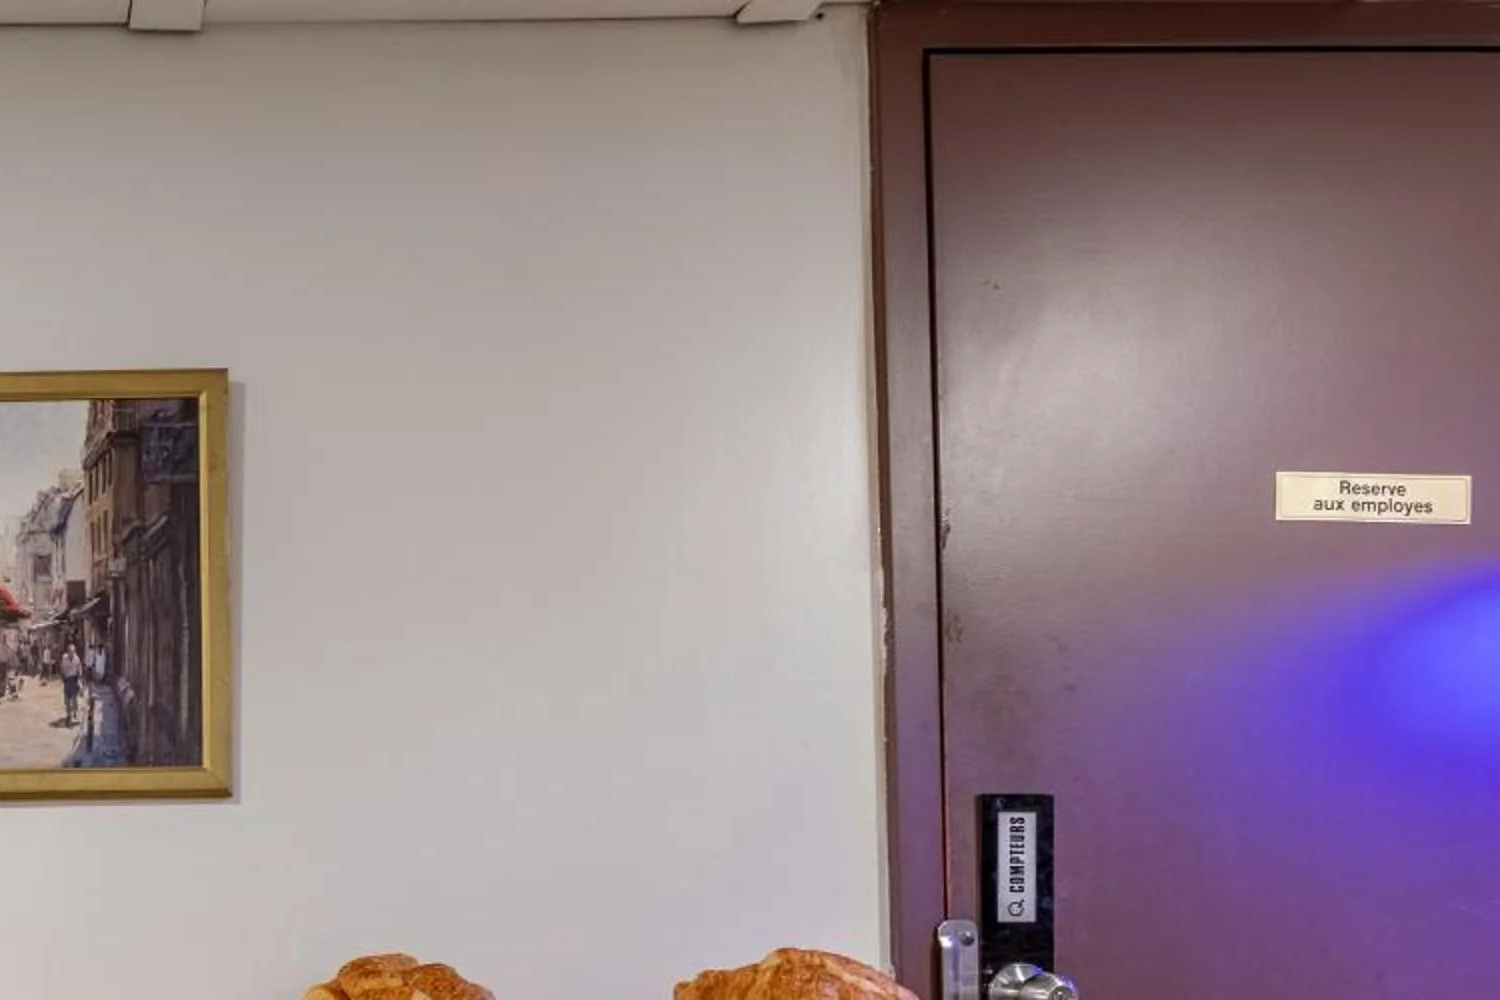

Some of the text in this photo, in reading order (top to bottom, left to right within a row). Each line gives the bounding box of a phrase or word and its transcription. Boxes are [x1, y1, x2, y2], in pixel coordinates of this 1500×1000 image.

[1339, 480, 1407, 497] Reserve
[1313, 498, 1433, 516] aux employes
[1009, 817, 1025, 893] COMPTEURS
